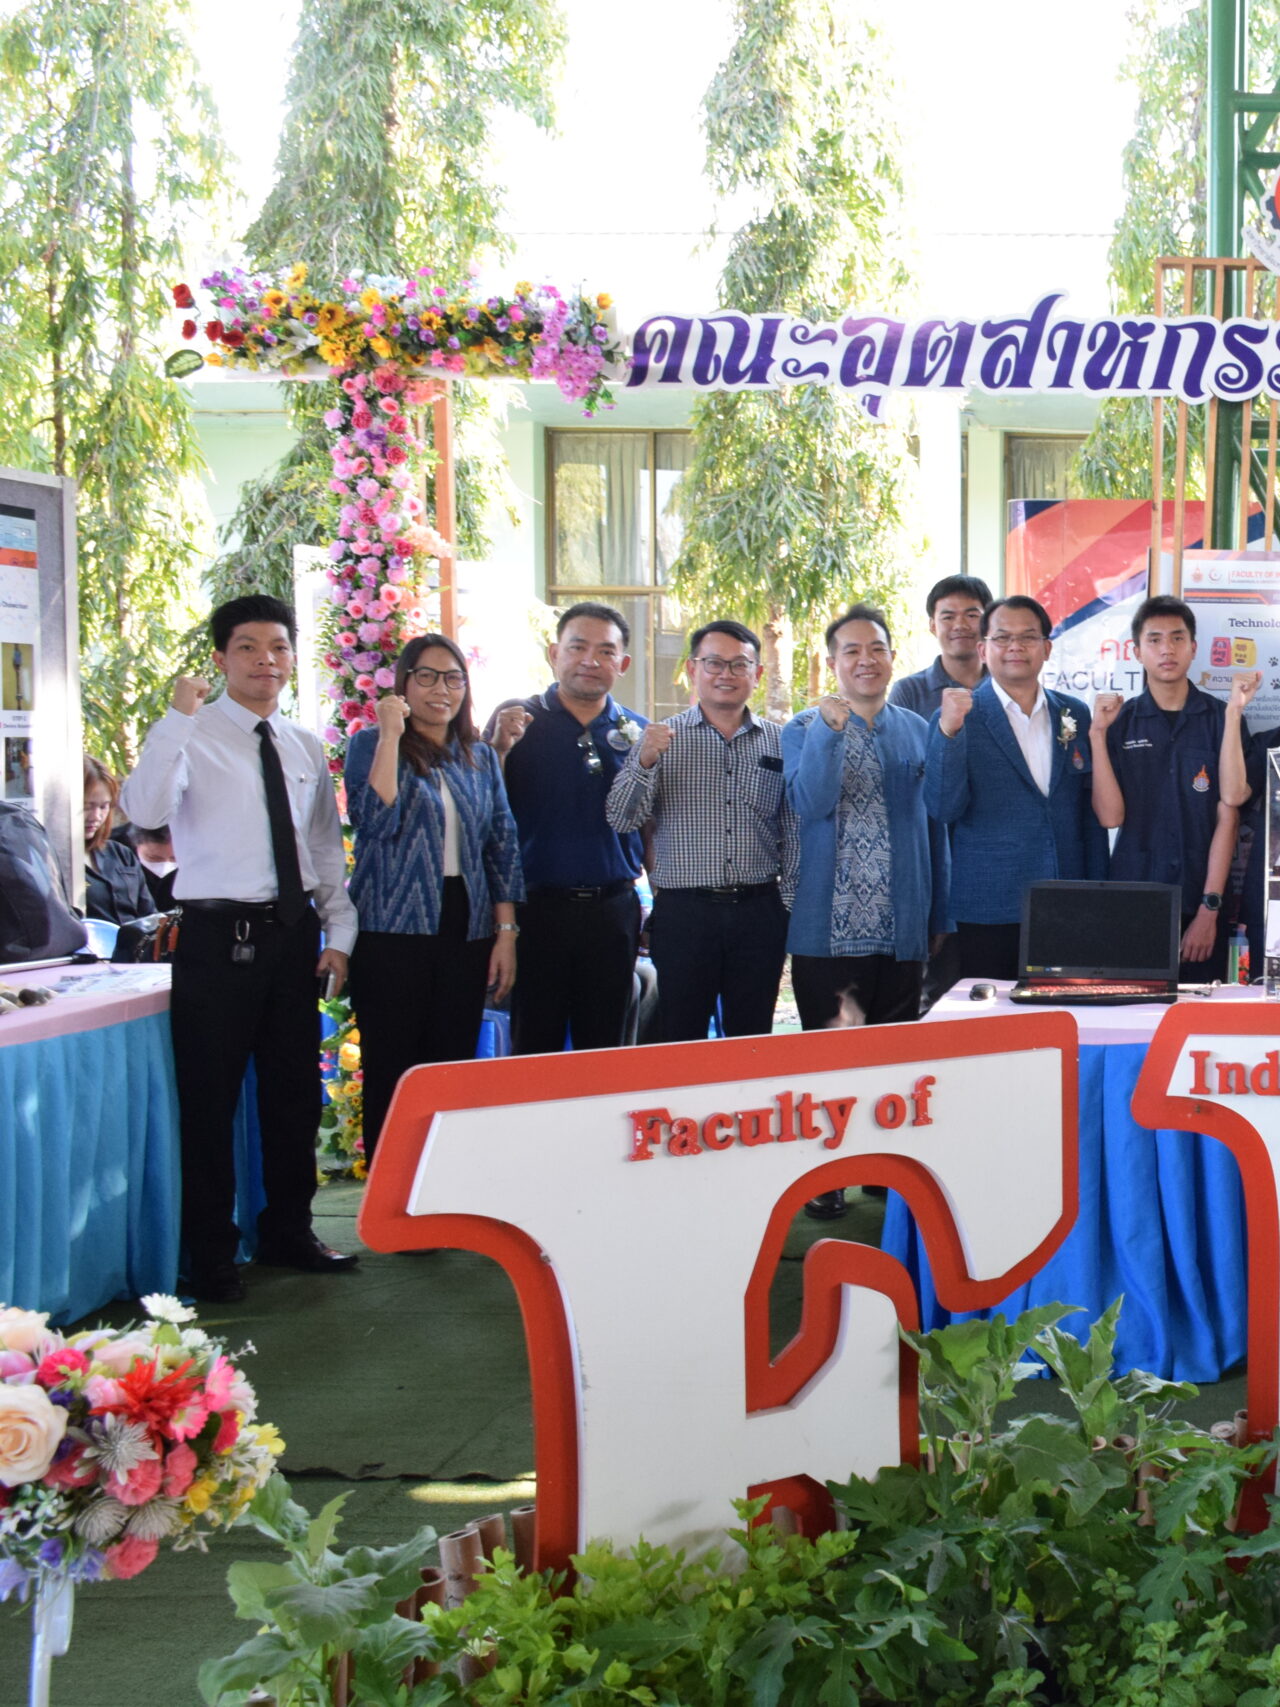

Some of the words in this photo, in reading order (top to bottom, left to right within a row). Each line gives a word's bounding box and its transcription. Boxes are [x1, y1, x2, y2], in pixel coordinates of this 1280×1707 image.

[1042, 671, 1140, 692] FACULT
[627, 1090, 857, 1162] Faculty
[875, 1074, 937, 1130] of
